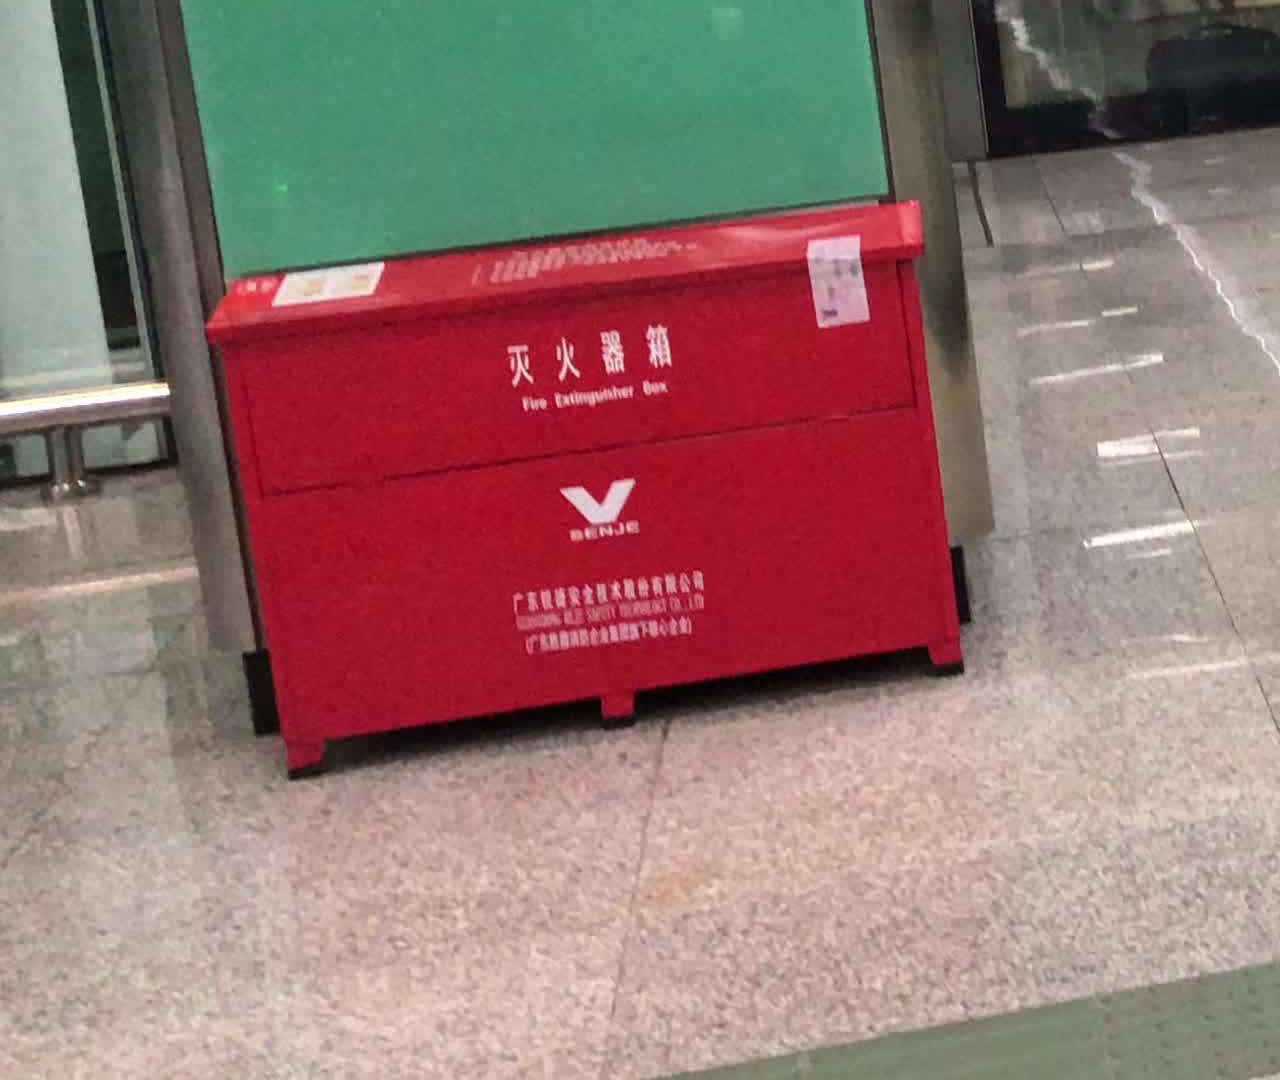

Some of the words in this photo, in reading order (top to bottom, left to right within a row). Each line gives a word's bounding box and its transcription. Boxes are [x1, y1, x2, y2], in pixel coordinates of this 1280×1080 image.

[507, 324, 673, 388] 灭火器箱
[522, 396, 548, 412] Fire
[554, 385, 634, 409] Extinguisher
[642, 379, 668, 396] Box
